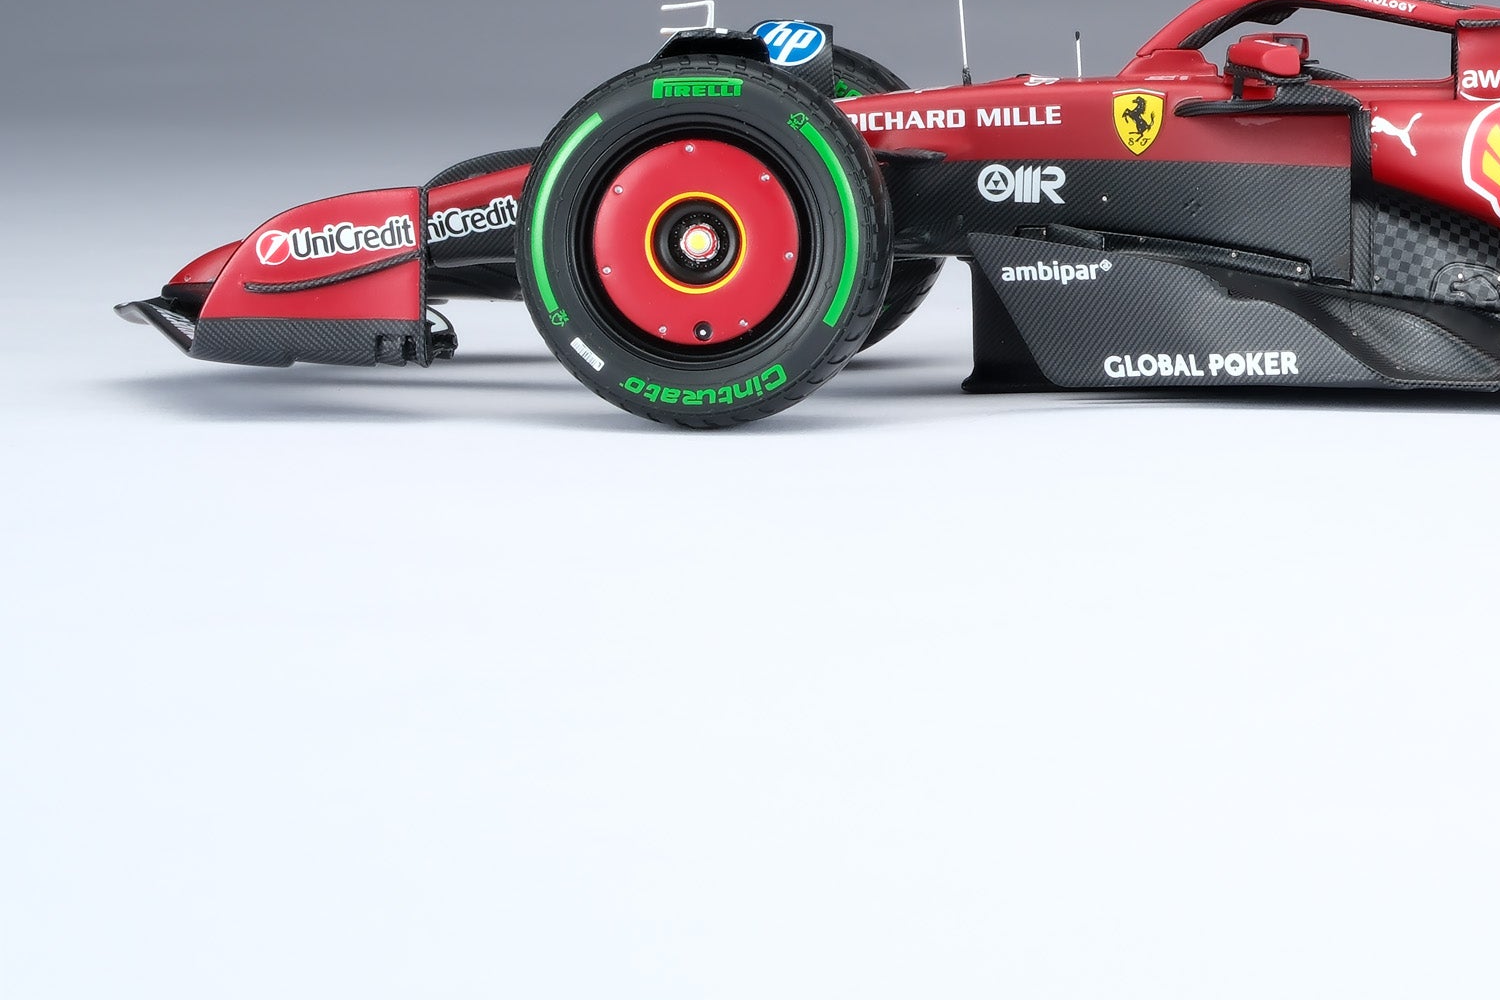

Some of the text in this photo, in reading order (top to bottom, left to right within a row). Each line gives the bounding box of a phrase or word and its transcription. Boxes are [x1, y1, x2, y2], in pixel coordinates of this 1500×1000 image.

[764, 21, 818, 64] hp
[652, 77, 744, 99] PIRELLI
[977, 105, 1062, 128] MILLE
[427, 199, 517, 240] niCredit
[292, 218, 415, 258] UniCredit
[1001, 261, 1099, 285] ambipar
[1104, 351, 1299, 378] GLOBAL POKER
